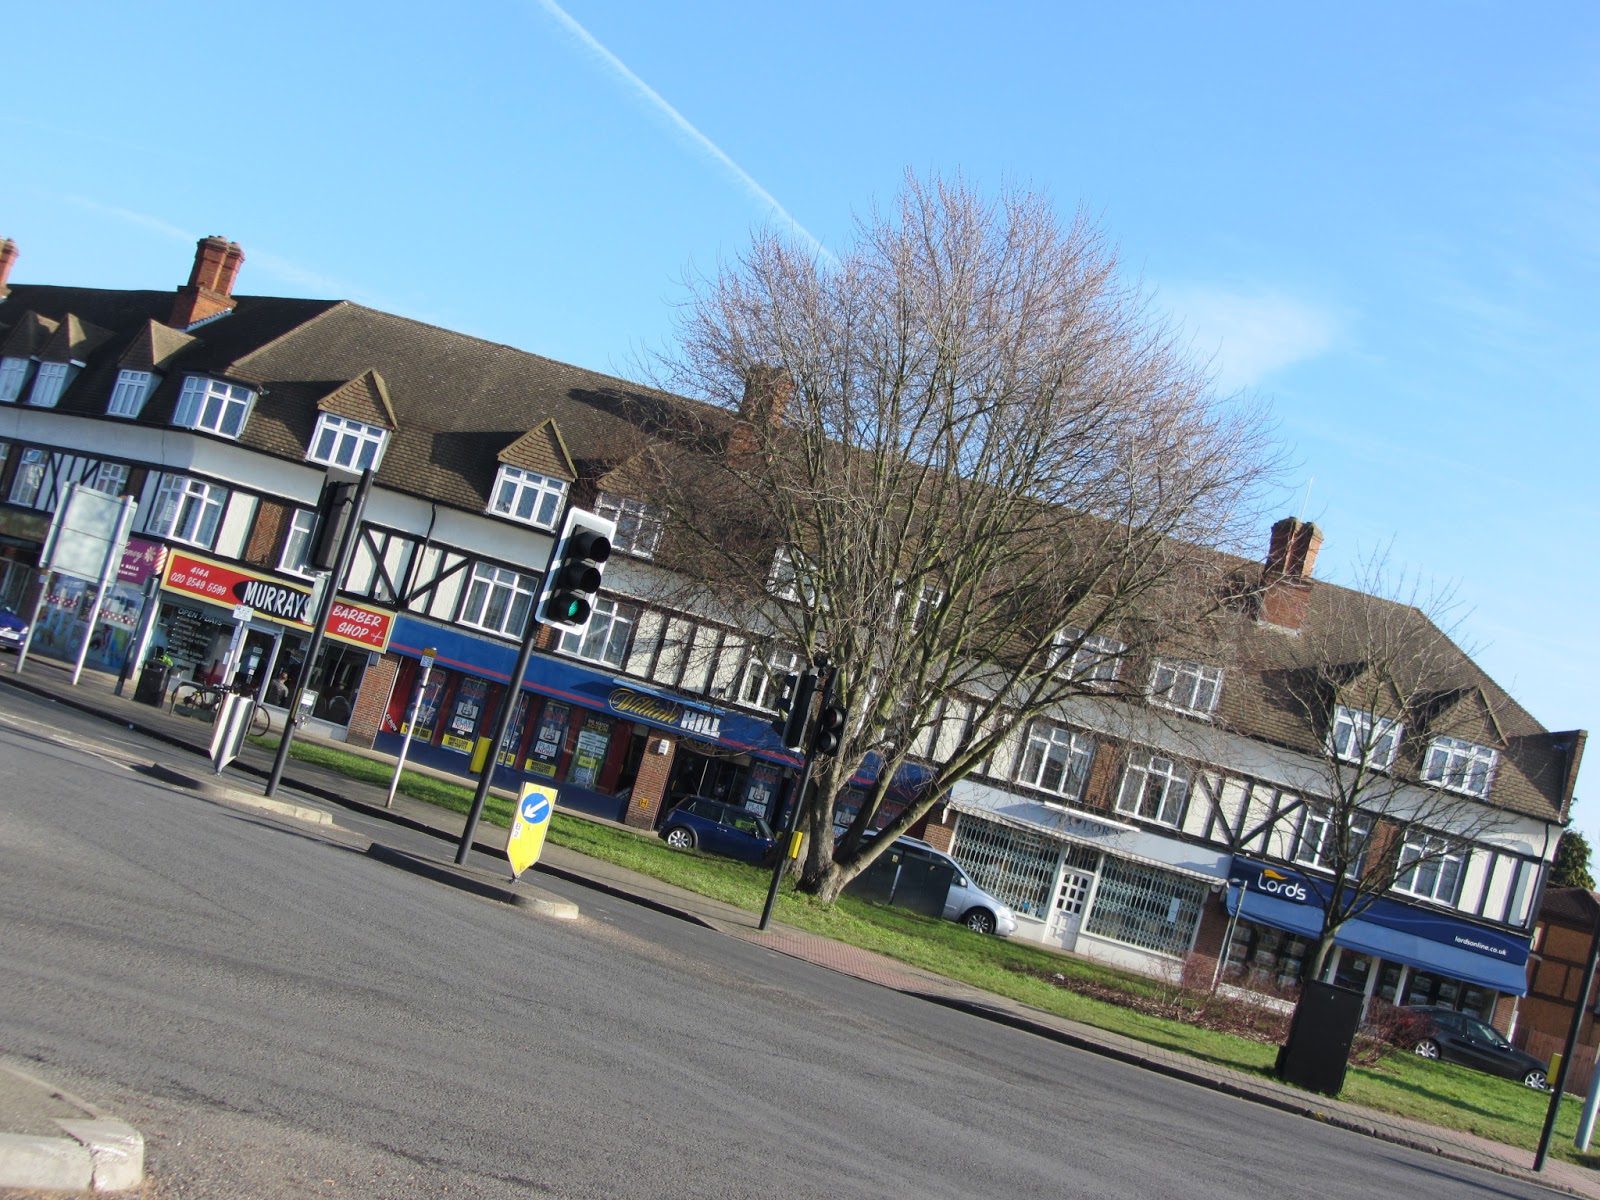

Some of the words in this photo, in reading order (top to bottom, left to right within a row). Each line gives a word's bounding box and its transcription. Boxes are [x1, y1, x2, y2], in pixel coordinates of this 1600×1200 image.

[170, 572, 186, 584] 020
[190, 566, 210, 578] 414A
[177, 607, 199, 619] OPEN
[332, 605, 382, 627] BARBER
[337, 621, 369, 638] SHOP
[608, 687, 679, 724] William
[680, 709, 720, 738] HILL
[1257, 872, 1306, 901] Lords
[1454, 935, 1507, 956] lordsonline.co.uk
